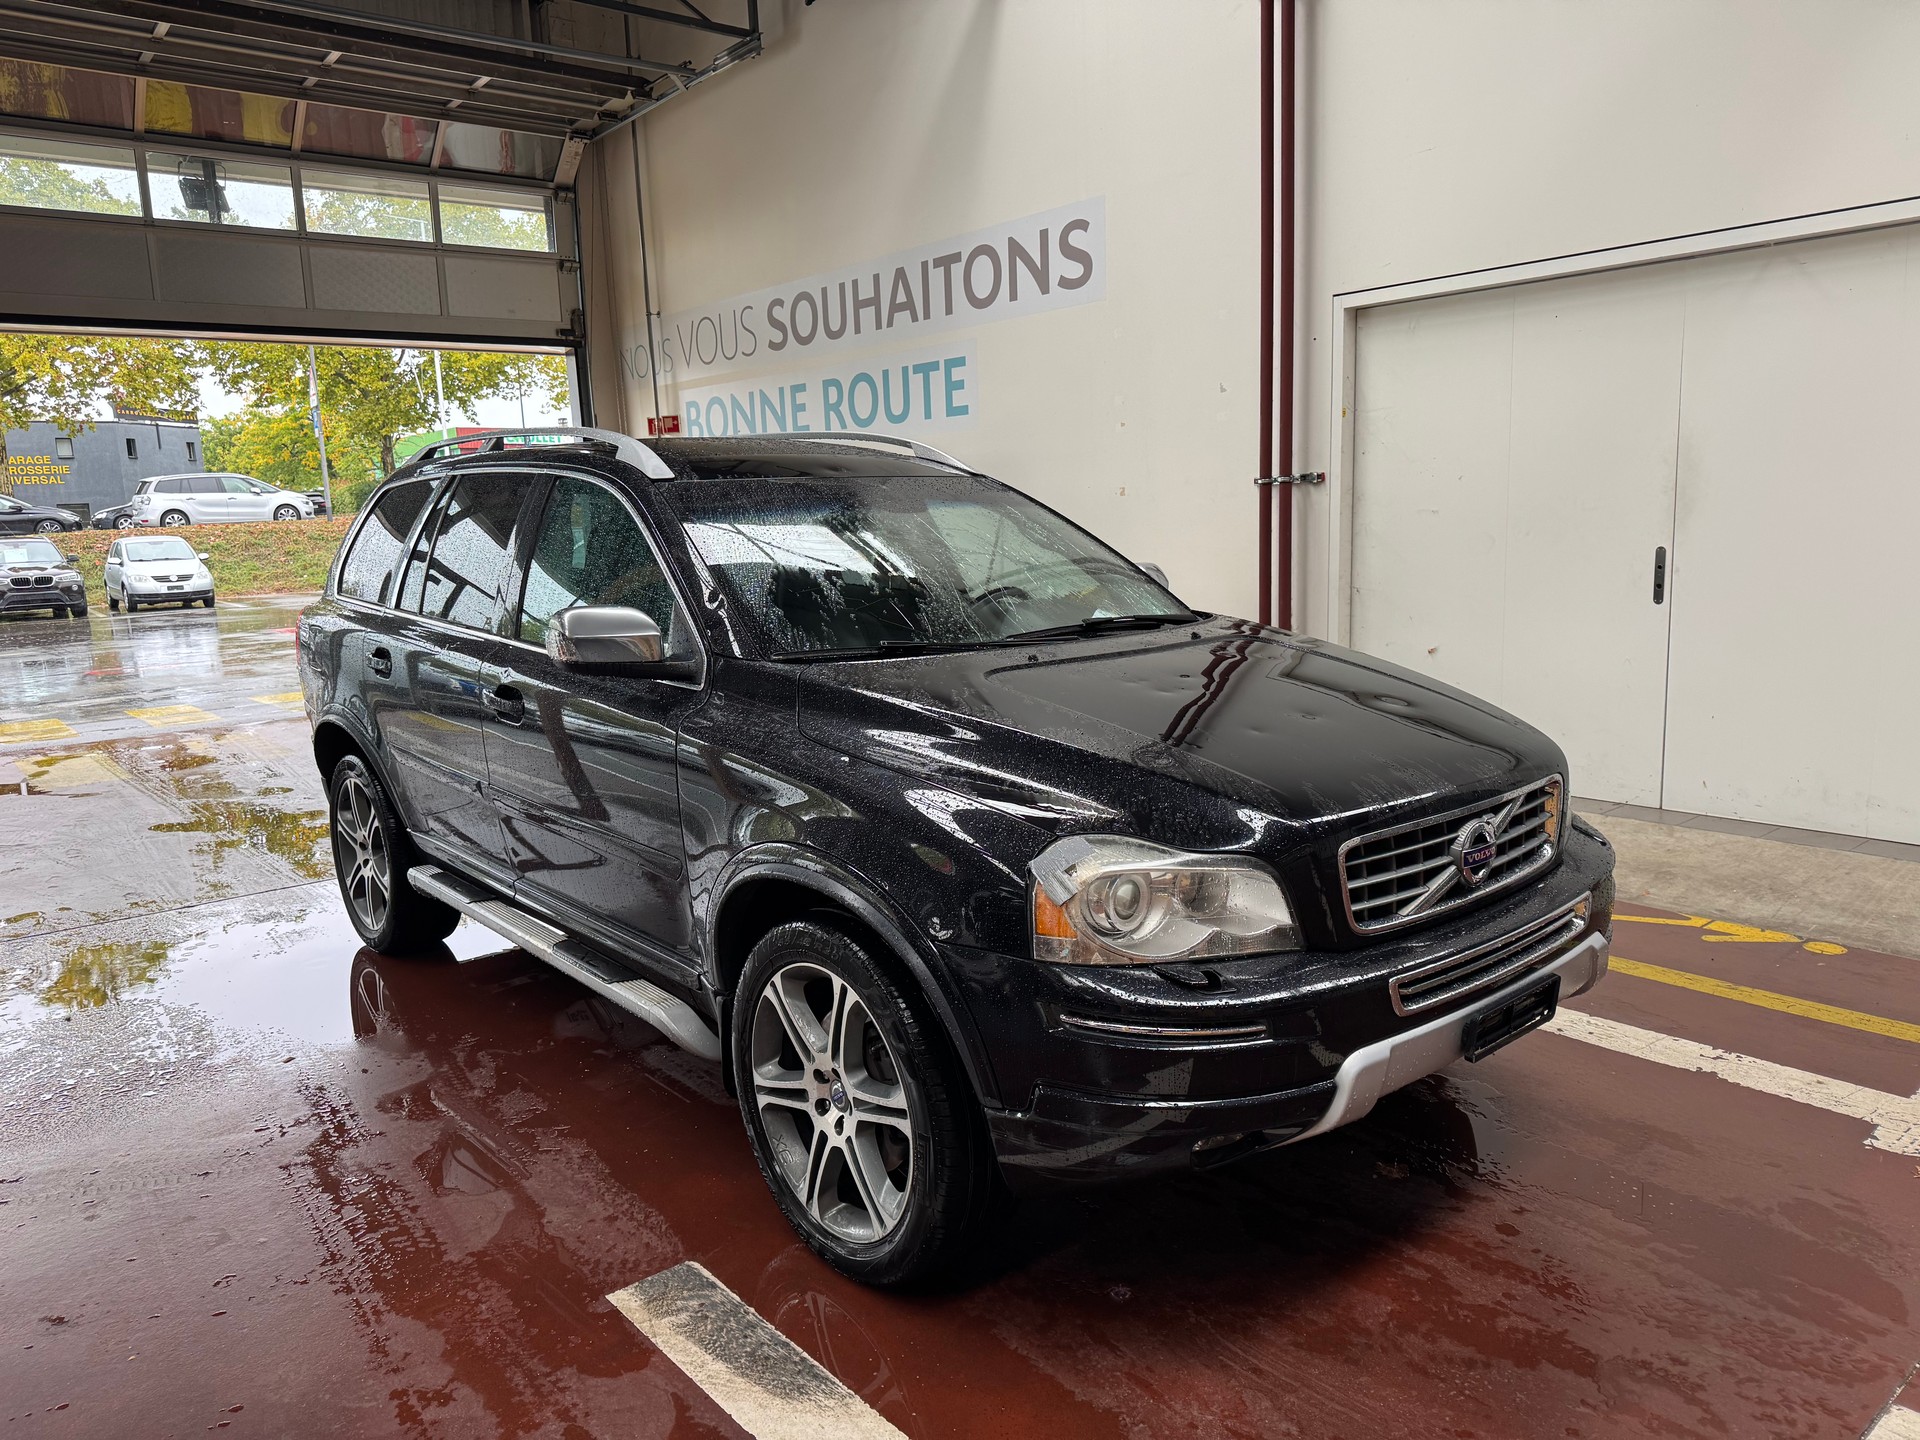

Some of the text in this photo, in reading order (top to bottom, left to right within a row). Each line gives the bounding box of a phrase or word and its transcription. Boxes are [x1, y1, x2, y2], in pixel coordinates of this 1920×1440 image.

[619, 218, 1094, 380] NOUS VOUS SOUHAITONS
[686, 356, 970, 437] BONNE ROUTE
[9, 455, 52, 465] ARAGE
[9, 465, 71, 475] ROSSERIE
[1466, 847, 1495, 862] VOLVO
